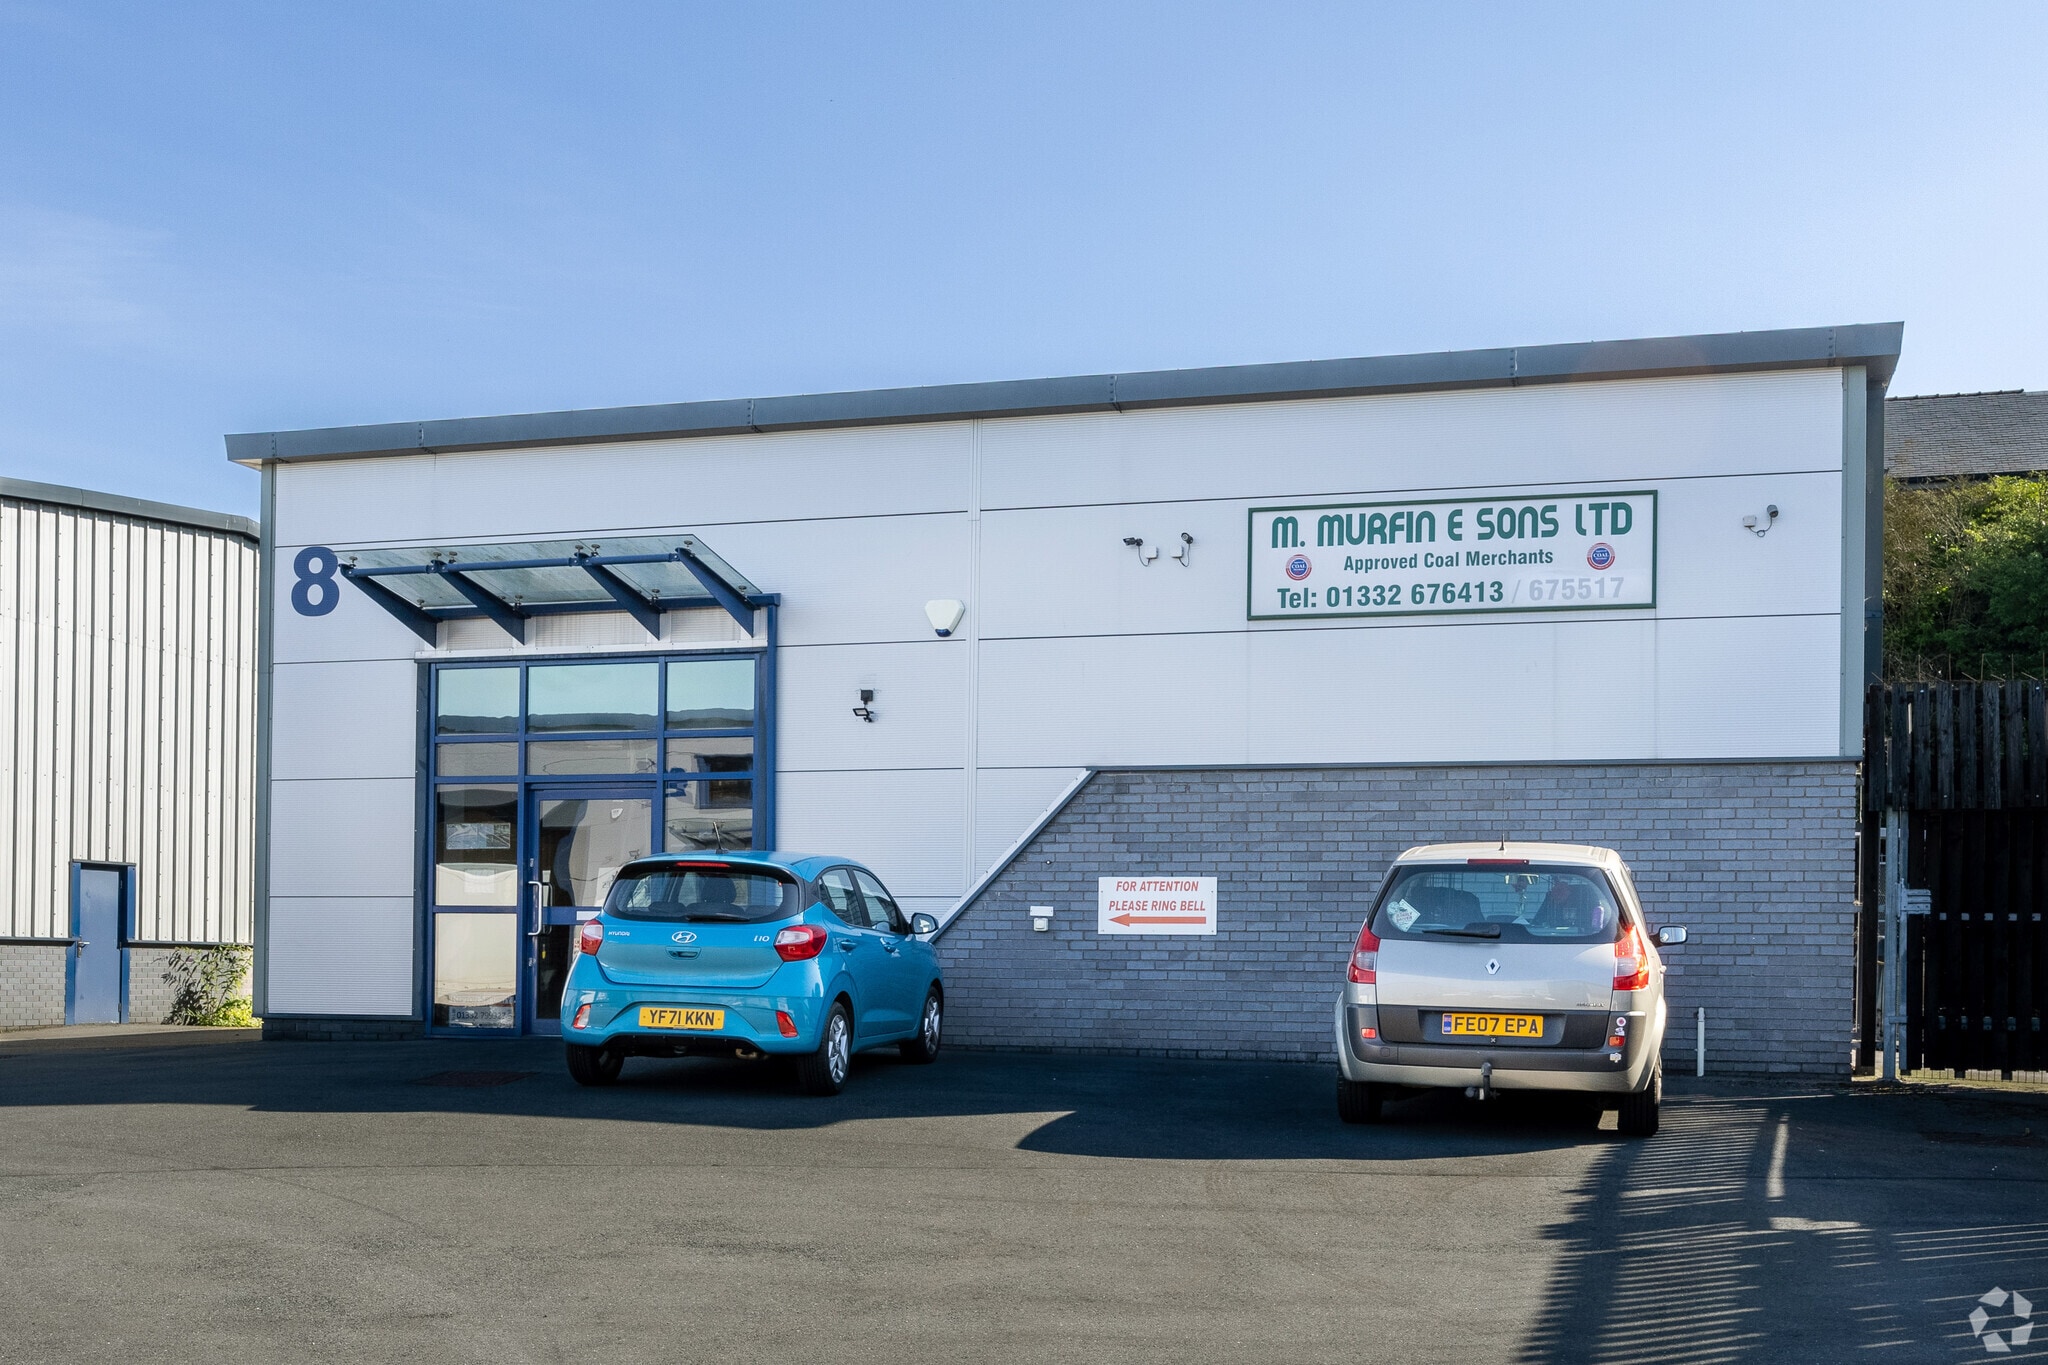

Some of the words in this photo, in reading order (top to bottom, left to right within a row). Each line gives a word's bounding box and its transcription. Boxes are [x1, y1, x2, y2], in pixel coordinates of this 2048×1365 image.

[1271, 515, 1306, 549] M.
[1316, 510, 1436, 547] MURFIN
[1477, 504, 1560, 540] SONS
[1574, 501, 1633, 537] LTD
[1343, 552, 1419, 574] Approved
[1424, 550, 1460, 569] Coal
[1465, 548, 1554, 567] Merchants
[291, 546, 340, 617] 8
[1277, 587, 1317, 609] Tel:
[1326, 584, 1402, 609] 01332
[1410, 581, 1504, 606] 676413
[1528, 577, 1625, 602] 675517
[1116, 881, 1137, 892] FOR
[1140, 880, 1199, 892] ATTENTION
[1109, 901, 1148, 911] PLEASE
[1151, 901, 1177, 911] RING
[1180, 901, 1206, 911] BELL
[649, 1010, 682, 1025] YF71
[685, 1011, 715, 1026] KKN
[1454, 1016, 1500, 1032] FE07
[1505, 1018, 1538, 1034] EPA
